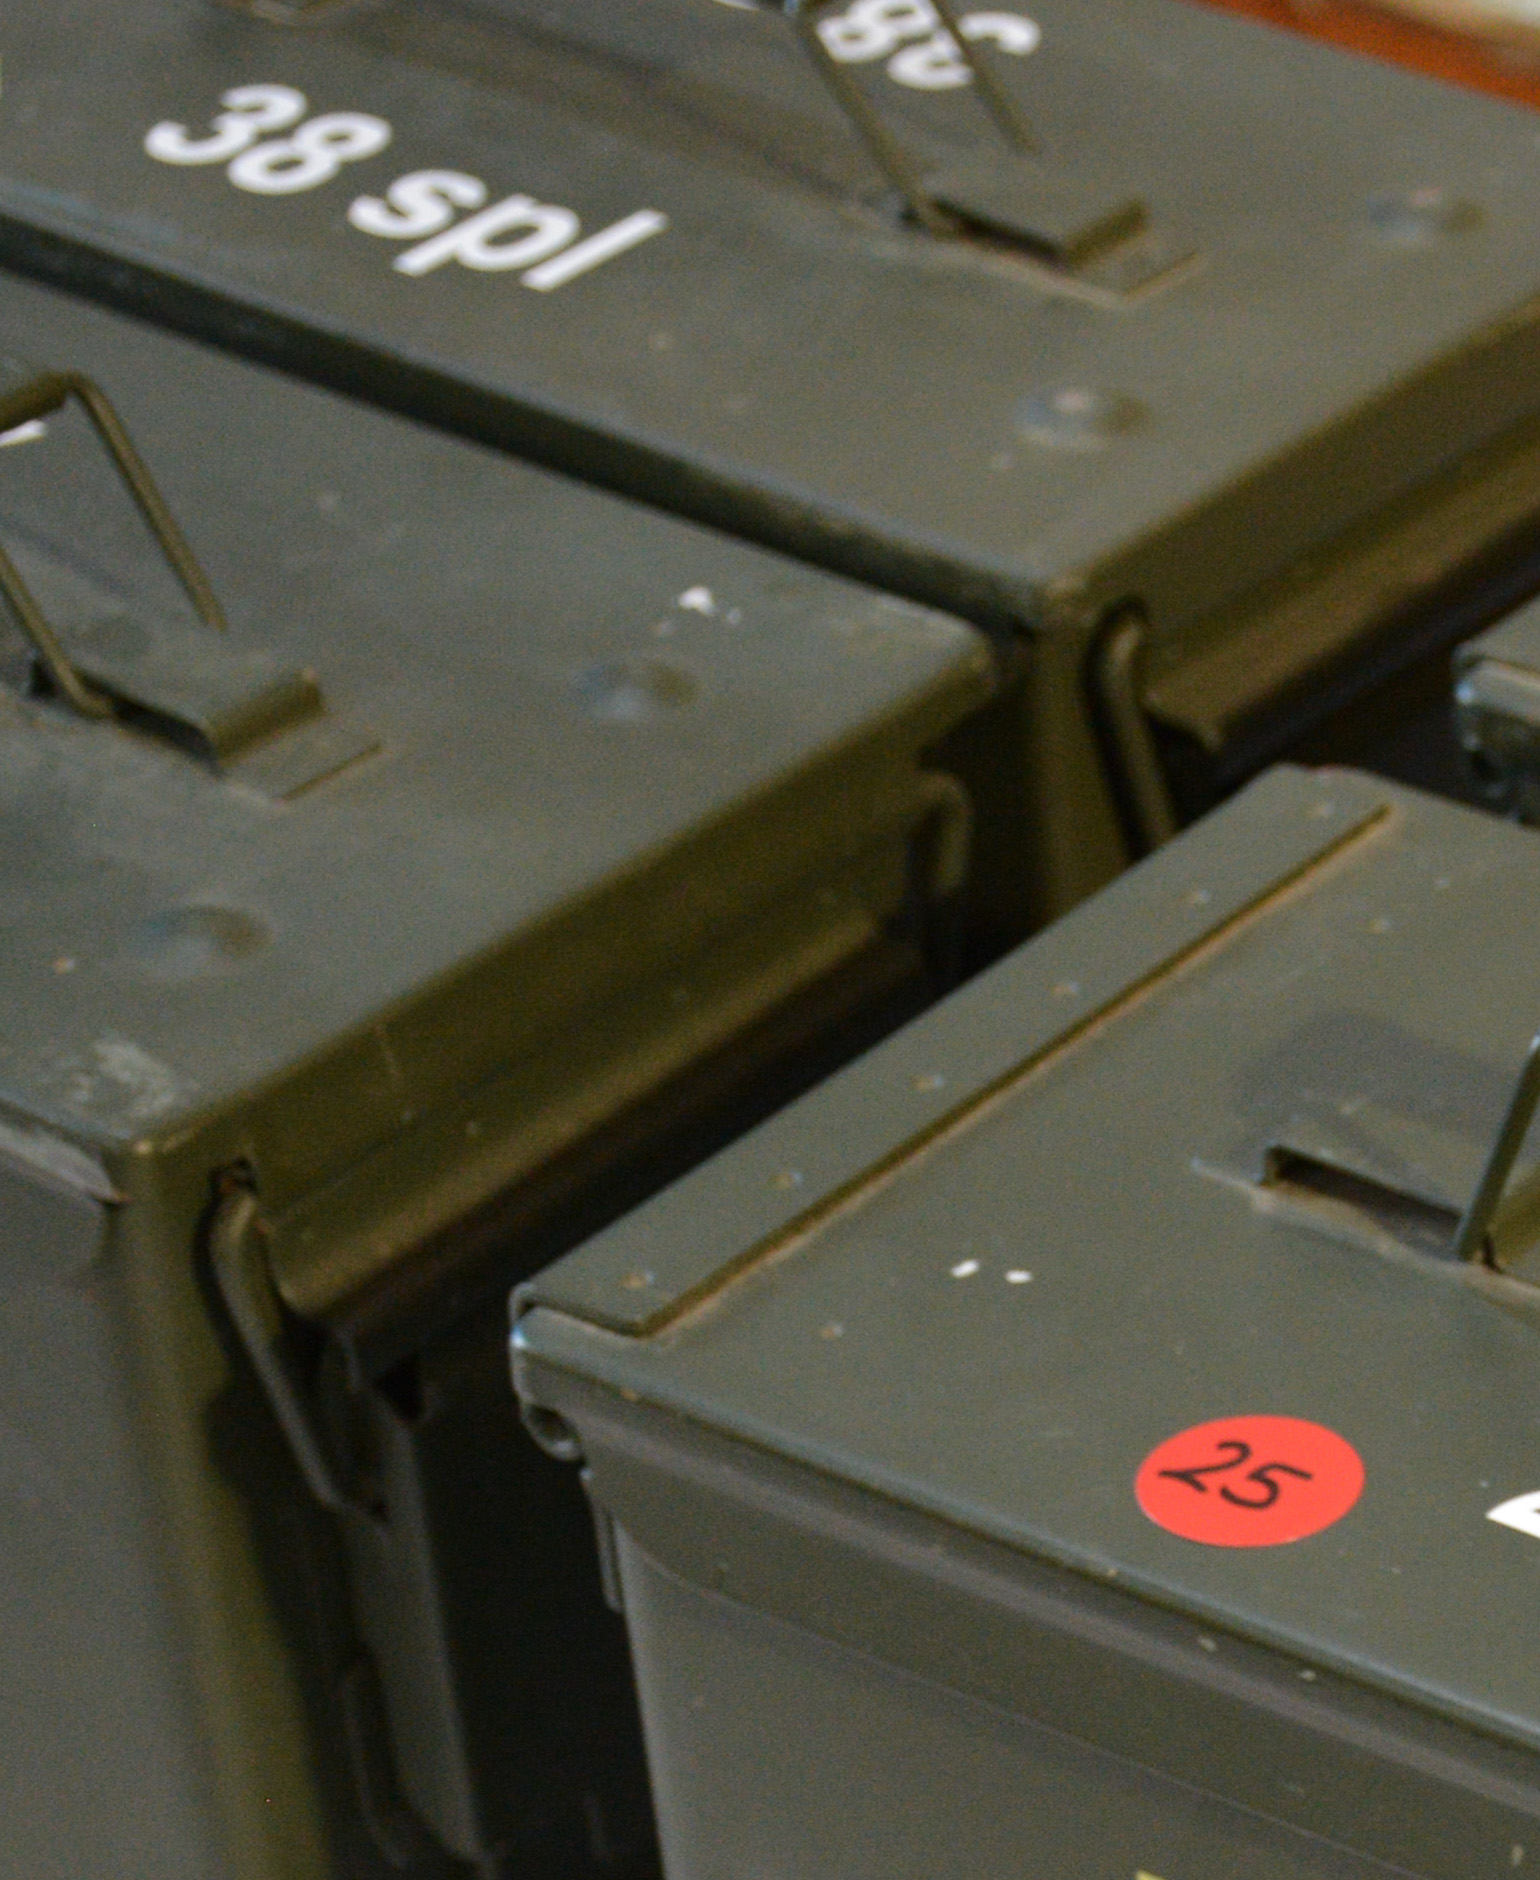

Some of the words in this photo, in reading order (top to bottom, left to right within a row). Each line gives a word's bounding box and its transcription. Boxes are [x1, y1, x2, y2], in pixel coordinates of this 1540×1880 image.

[143, 82, 393, 197] 38
[347, 168, 668, 293] spl
[1157, 1440, 1313, 1511] 25
